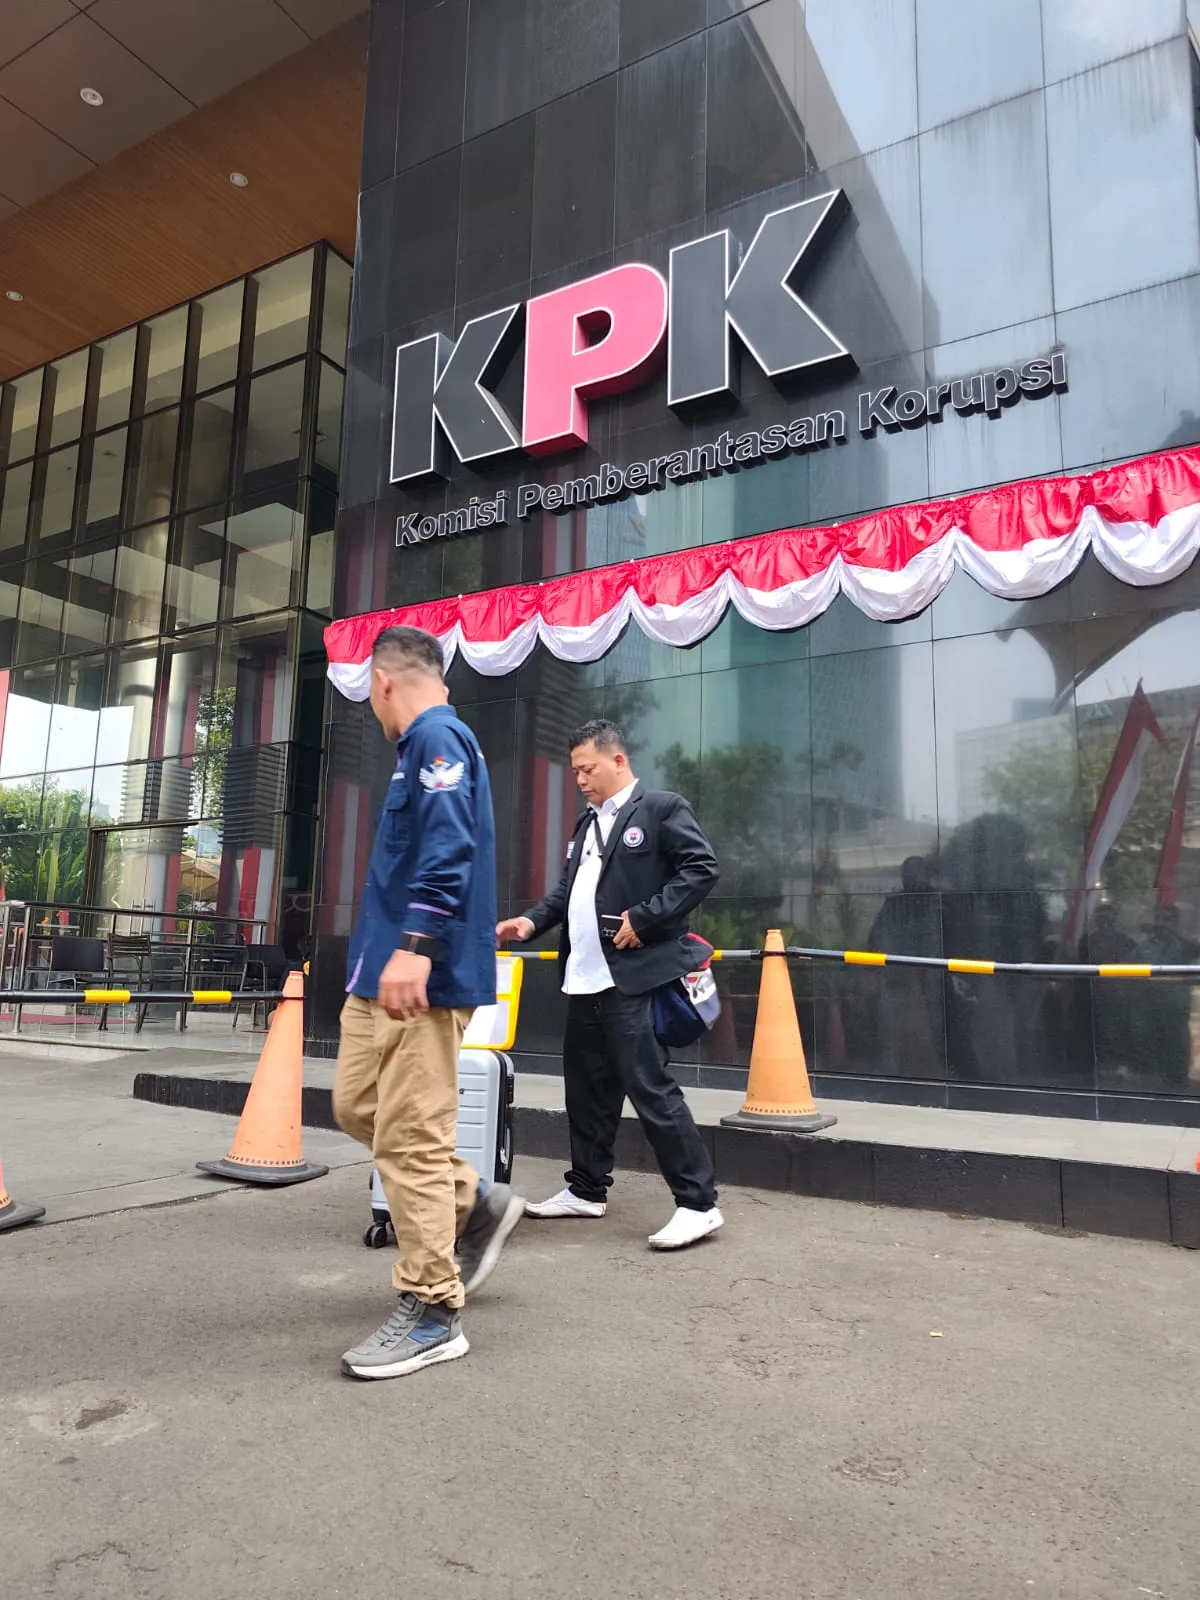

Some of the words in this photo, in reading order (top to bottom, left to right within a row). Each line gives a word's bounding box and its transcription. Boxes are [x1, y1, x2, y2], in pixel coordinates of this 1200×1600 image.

[390, 188, 850, 485] KPK
[395, 490, 505, 547] Komisi
[517, 409, 845, 518] Pemberantasan
[858, 352, 1066, 431] Korupsi
